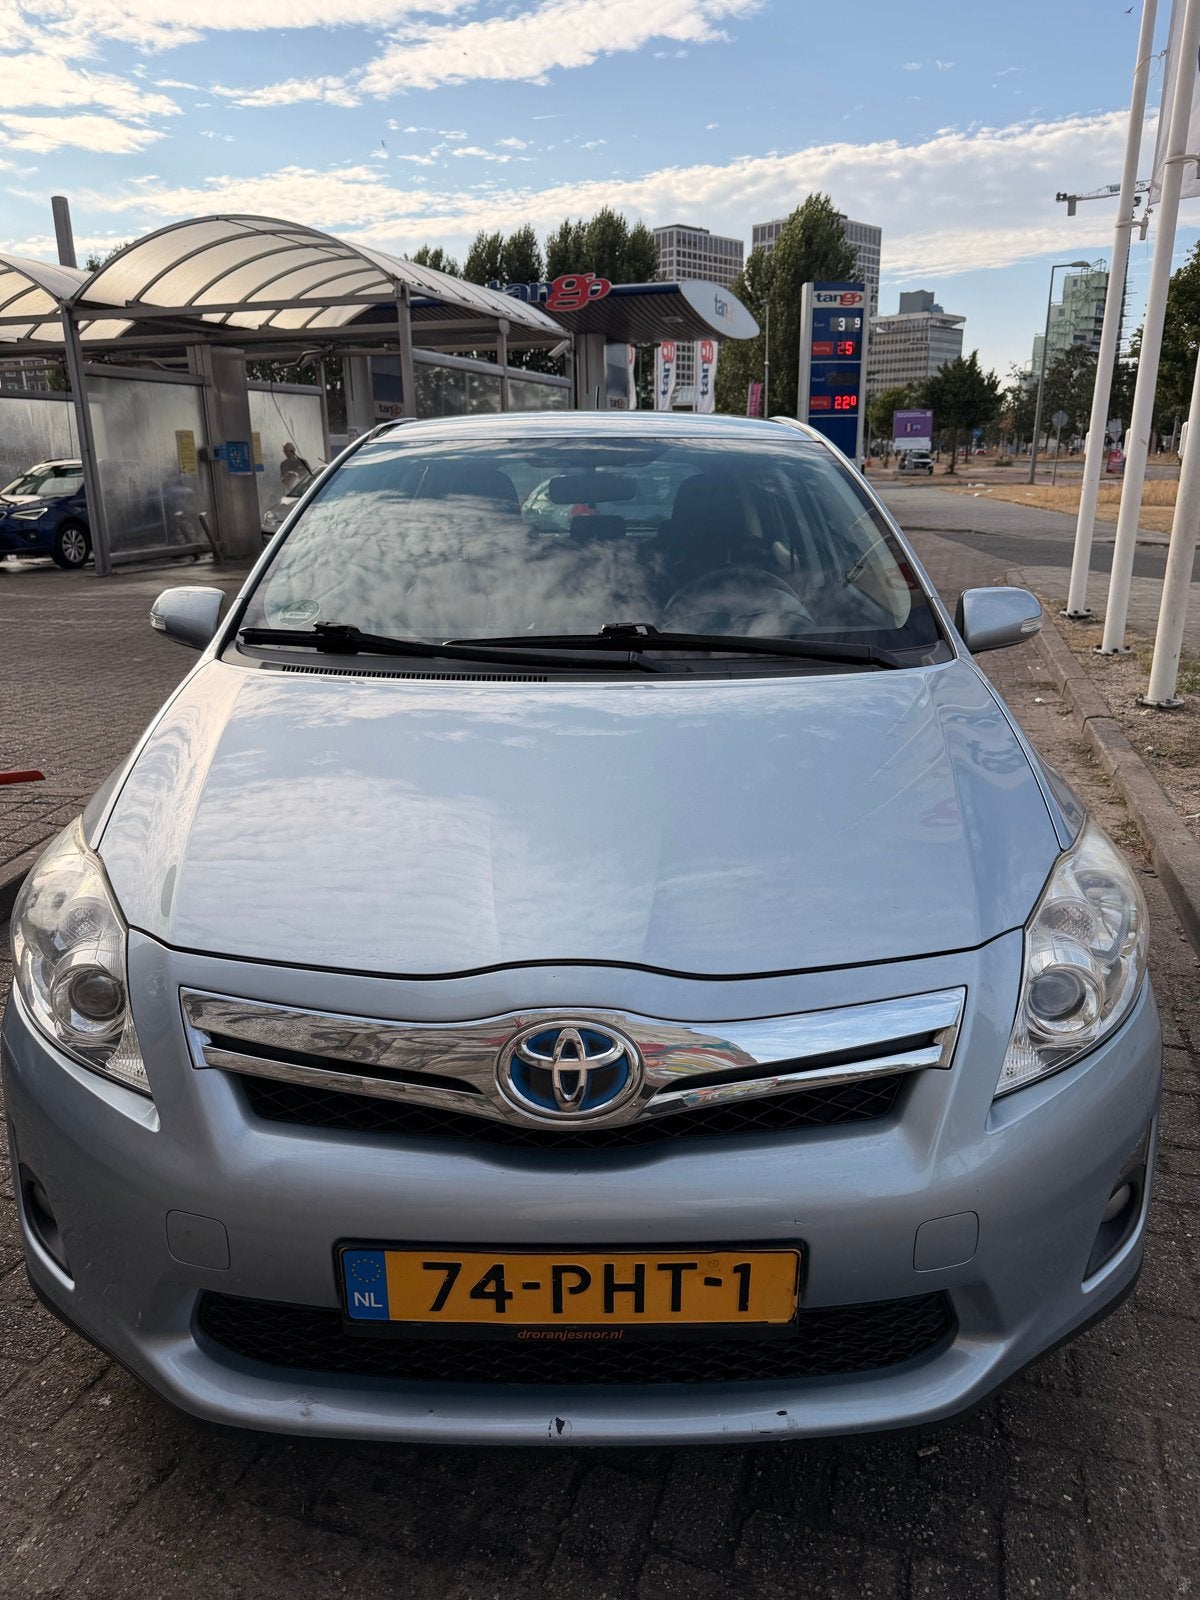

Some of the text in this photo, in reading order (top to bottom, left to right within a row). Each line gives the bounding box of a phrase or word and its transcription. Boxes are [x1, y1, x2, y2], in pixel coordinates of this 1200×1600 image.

[815, 292, 862, 306] tango
[422, 1261, 752, 1314] 74-PHT-1
[354, 1291, 383, 1307] NL
[517, 1329, 624, 1341] droranjesnor.nl
